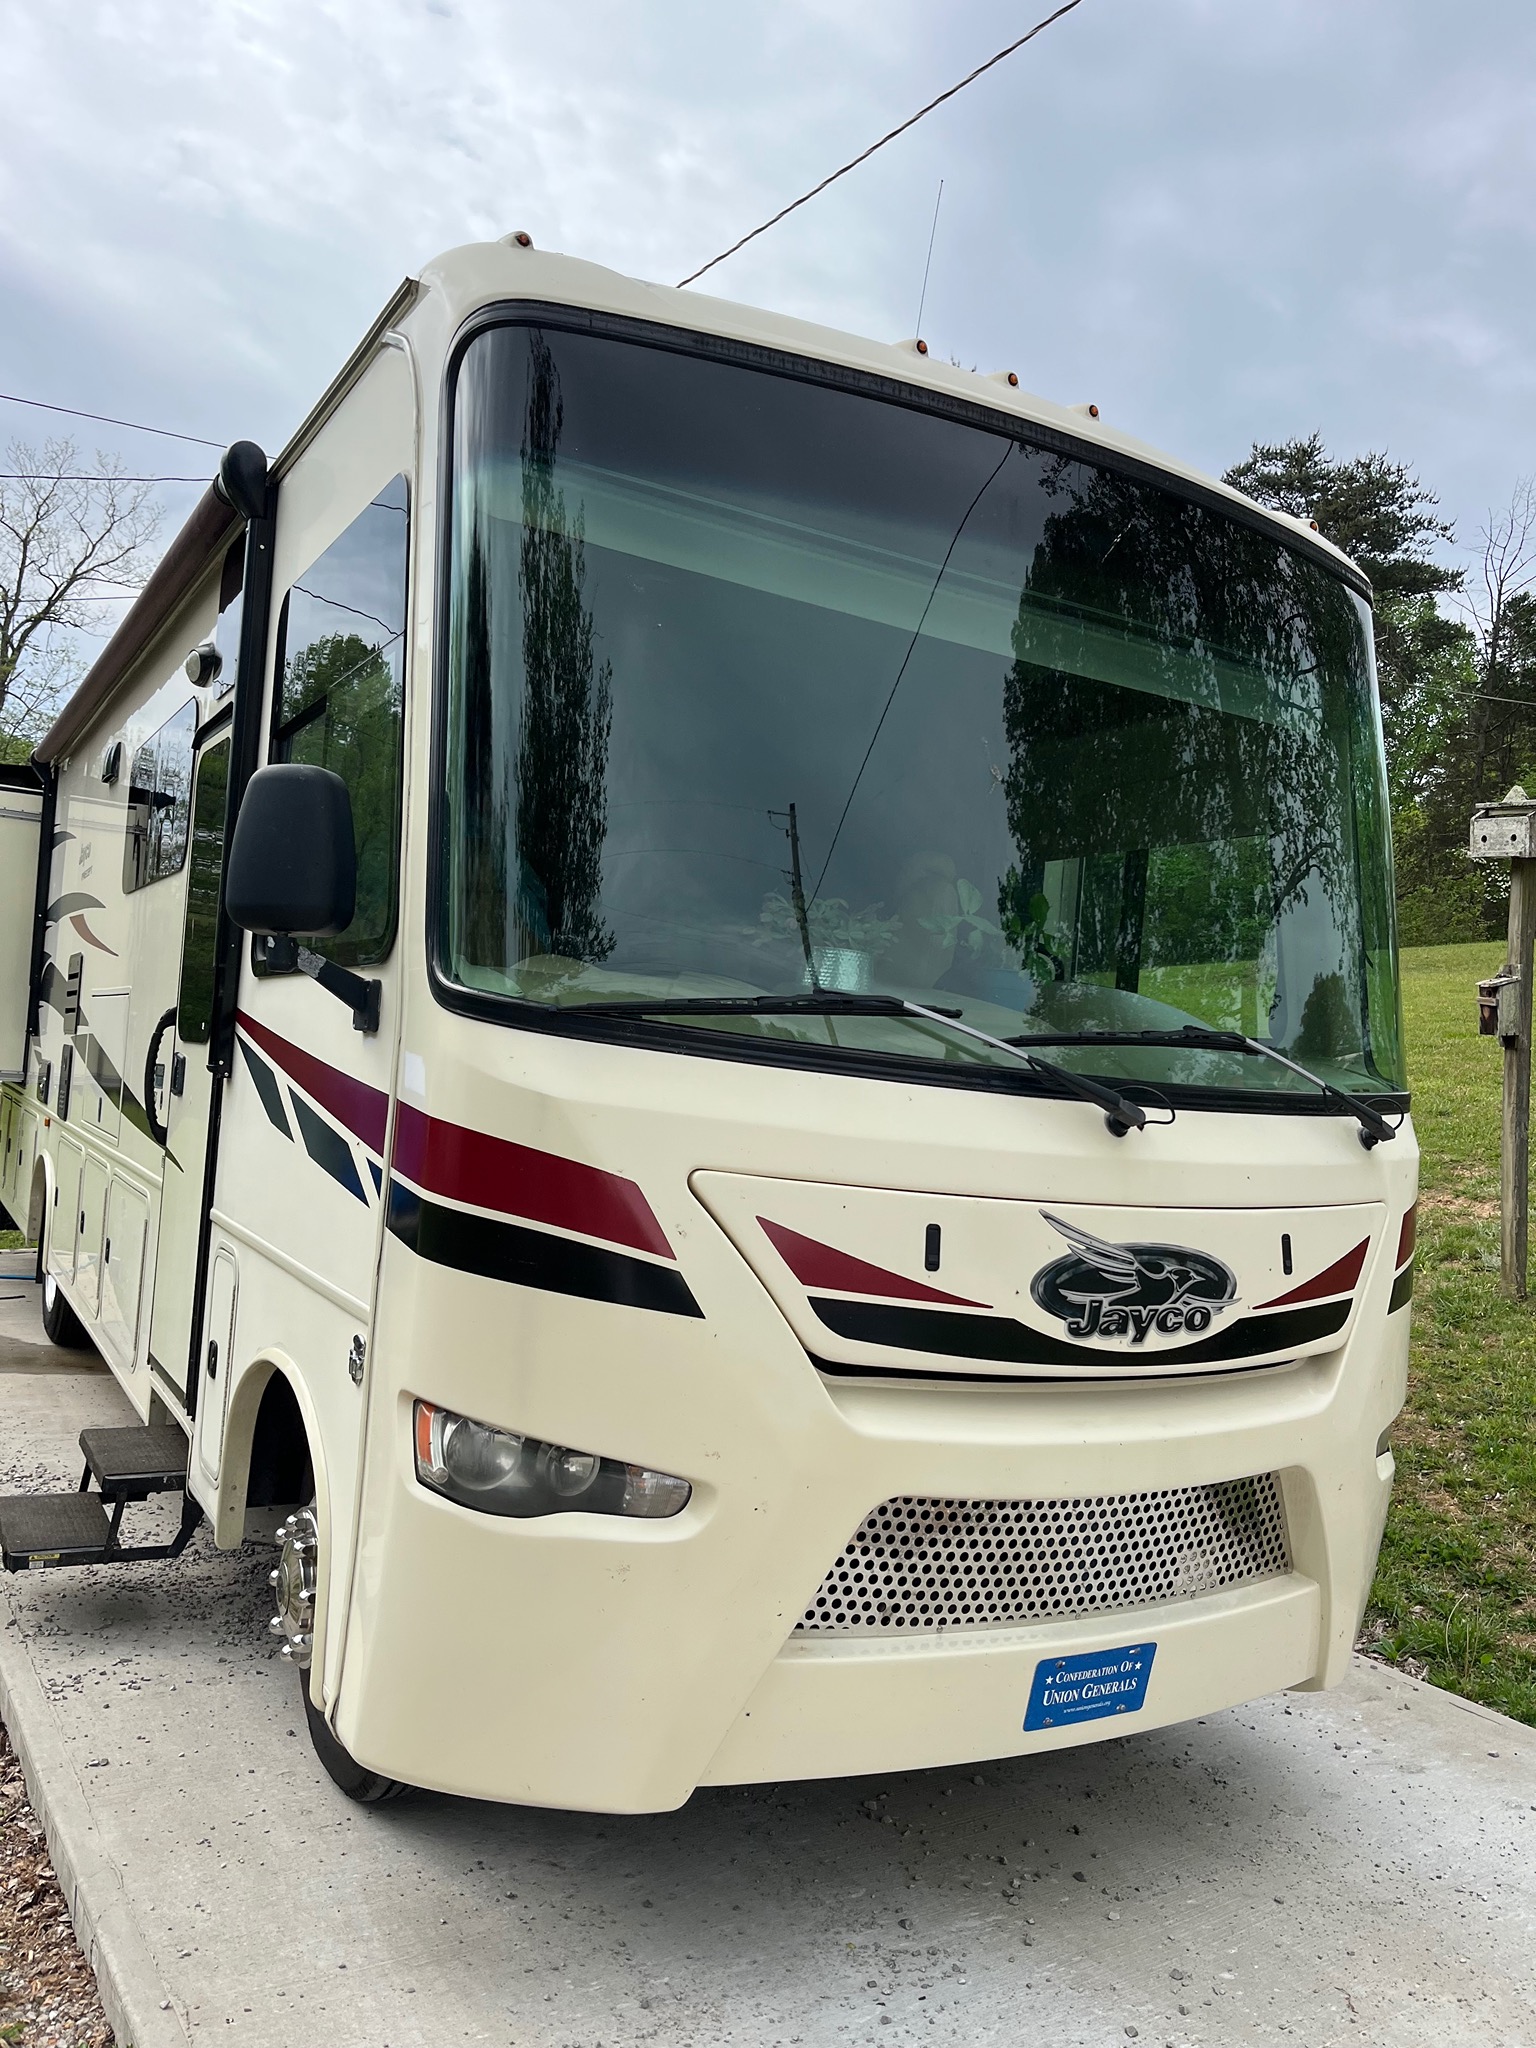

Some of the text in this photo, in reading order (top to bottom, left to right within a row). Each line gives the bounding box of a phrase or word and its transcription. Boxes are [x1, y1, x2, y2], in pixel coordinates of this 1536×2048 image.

[1065, 1299, 1213, 1346] Jayco
[1055, 1665, 1118, 1684] CONFEDERATION
[1043, 1677, 1138, 1706] UNION GENERALS
